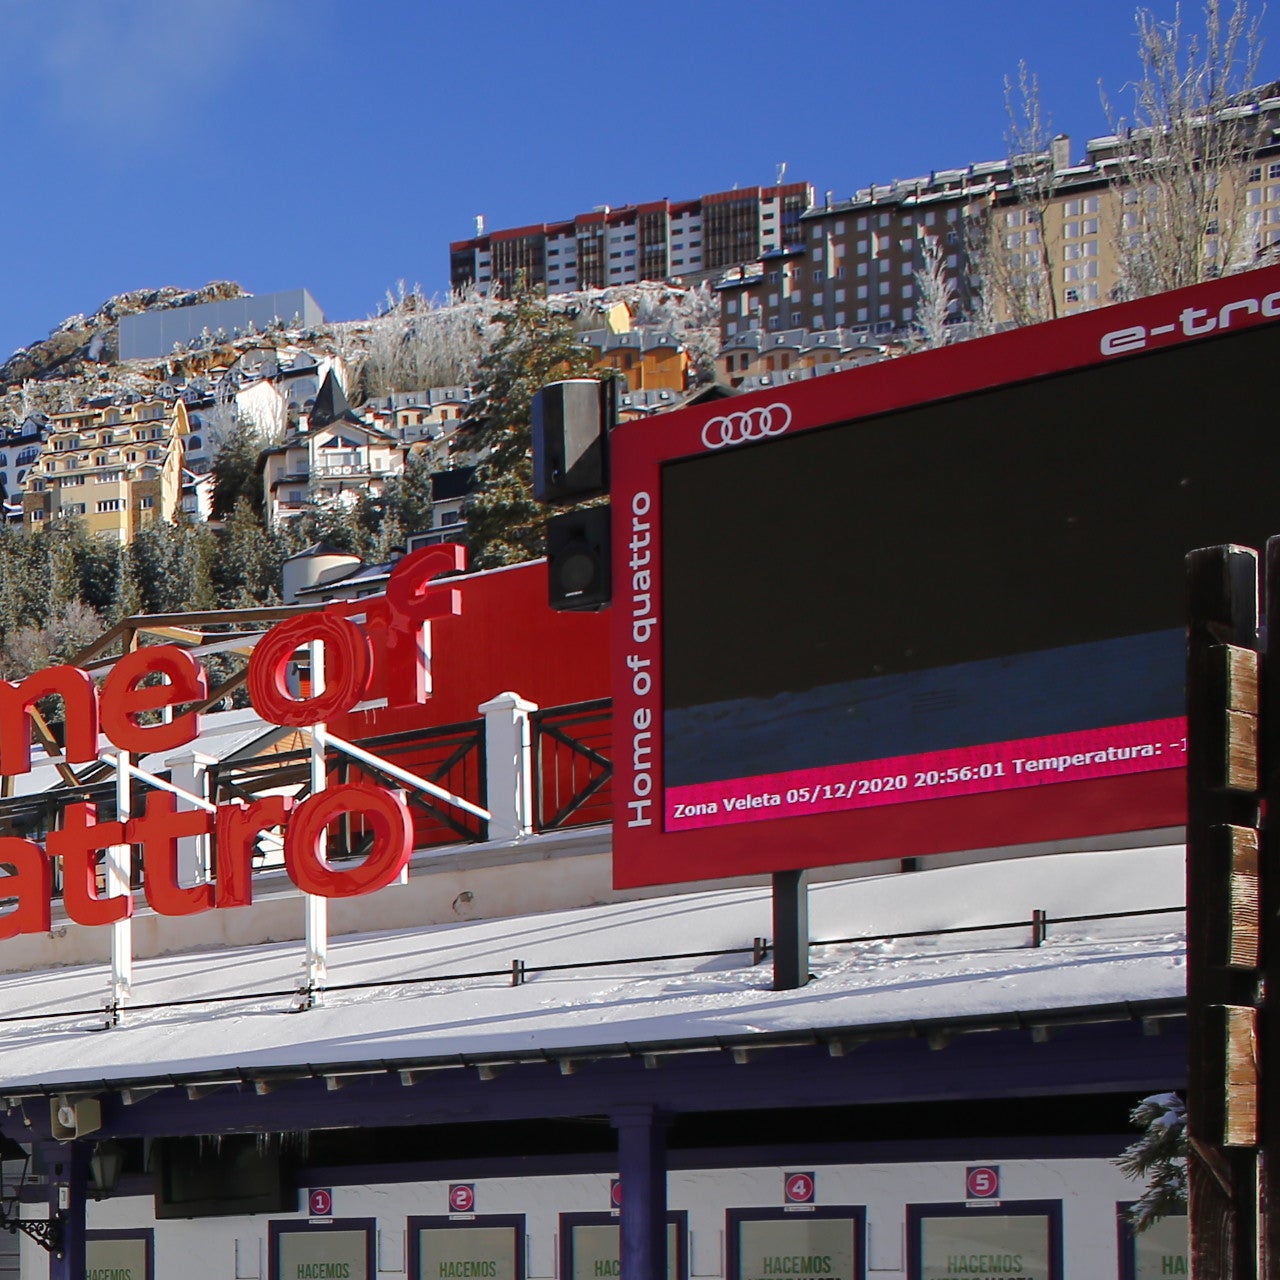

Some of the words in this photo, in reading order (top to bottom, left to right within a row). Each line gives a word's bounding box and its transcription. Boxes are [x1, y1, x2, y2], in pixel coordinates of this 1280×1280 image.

[628, 491, 657, 643] quattro
[248, 543, 466, 726] of
[626, 654, 652, 697] of
[627, 707, 652, 828] Home
[673, 801, 718, 818] Zona
[723, 792, 781, 812] Veleta
[786, 775, 908, 804] 05/12/2020
[914, 762, 1005, 787] 20:56:01
[1011, 741, 1162, 774] Temperatura:
[792, 1180, 806, 1195] 4
[976, 1174, 989, 1190] 5
[316, 1195, 324, 1209] 1
[456, 1191, 467, 1205] 2
[297, 1263, 350, 1279] HACEMOS
[440, 1261, 496, 1278] HACEMOS
[763, 1256, 831, 1274] HACEMOS
[947, 1254, 1023, 1274] HACEMOS
